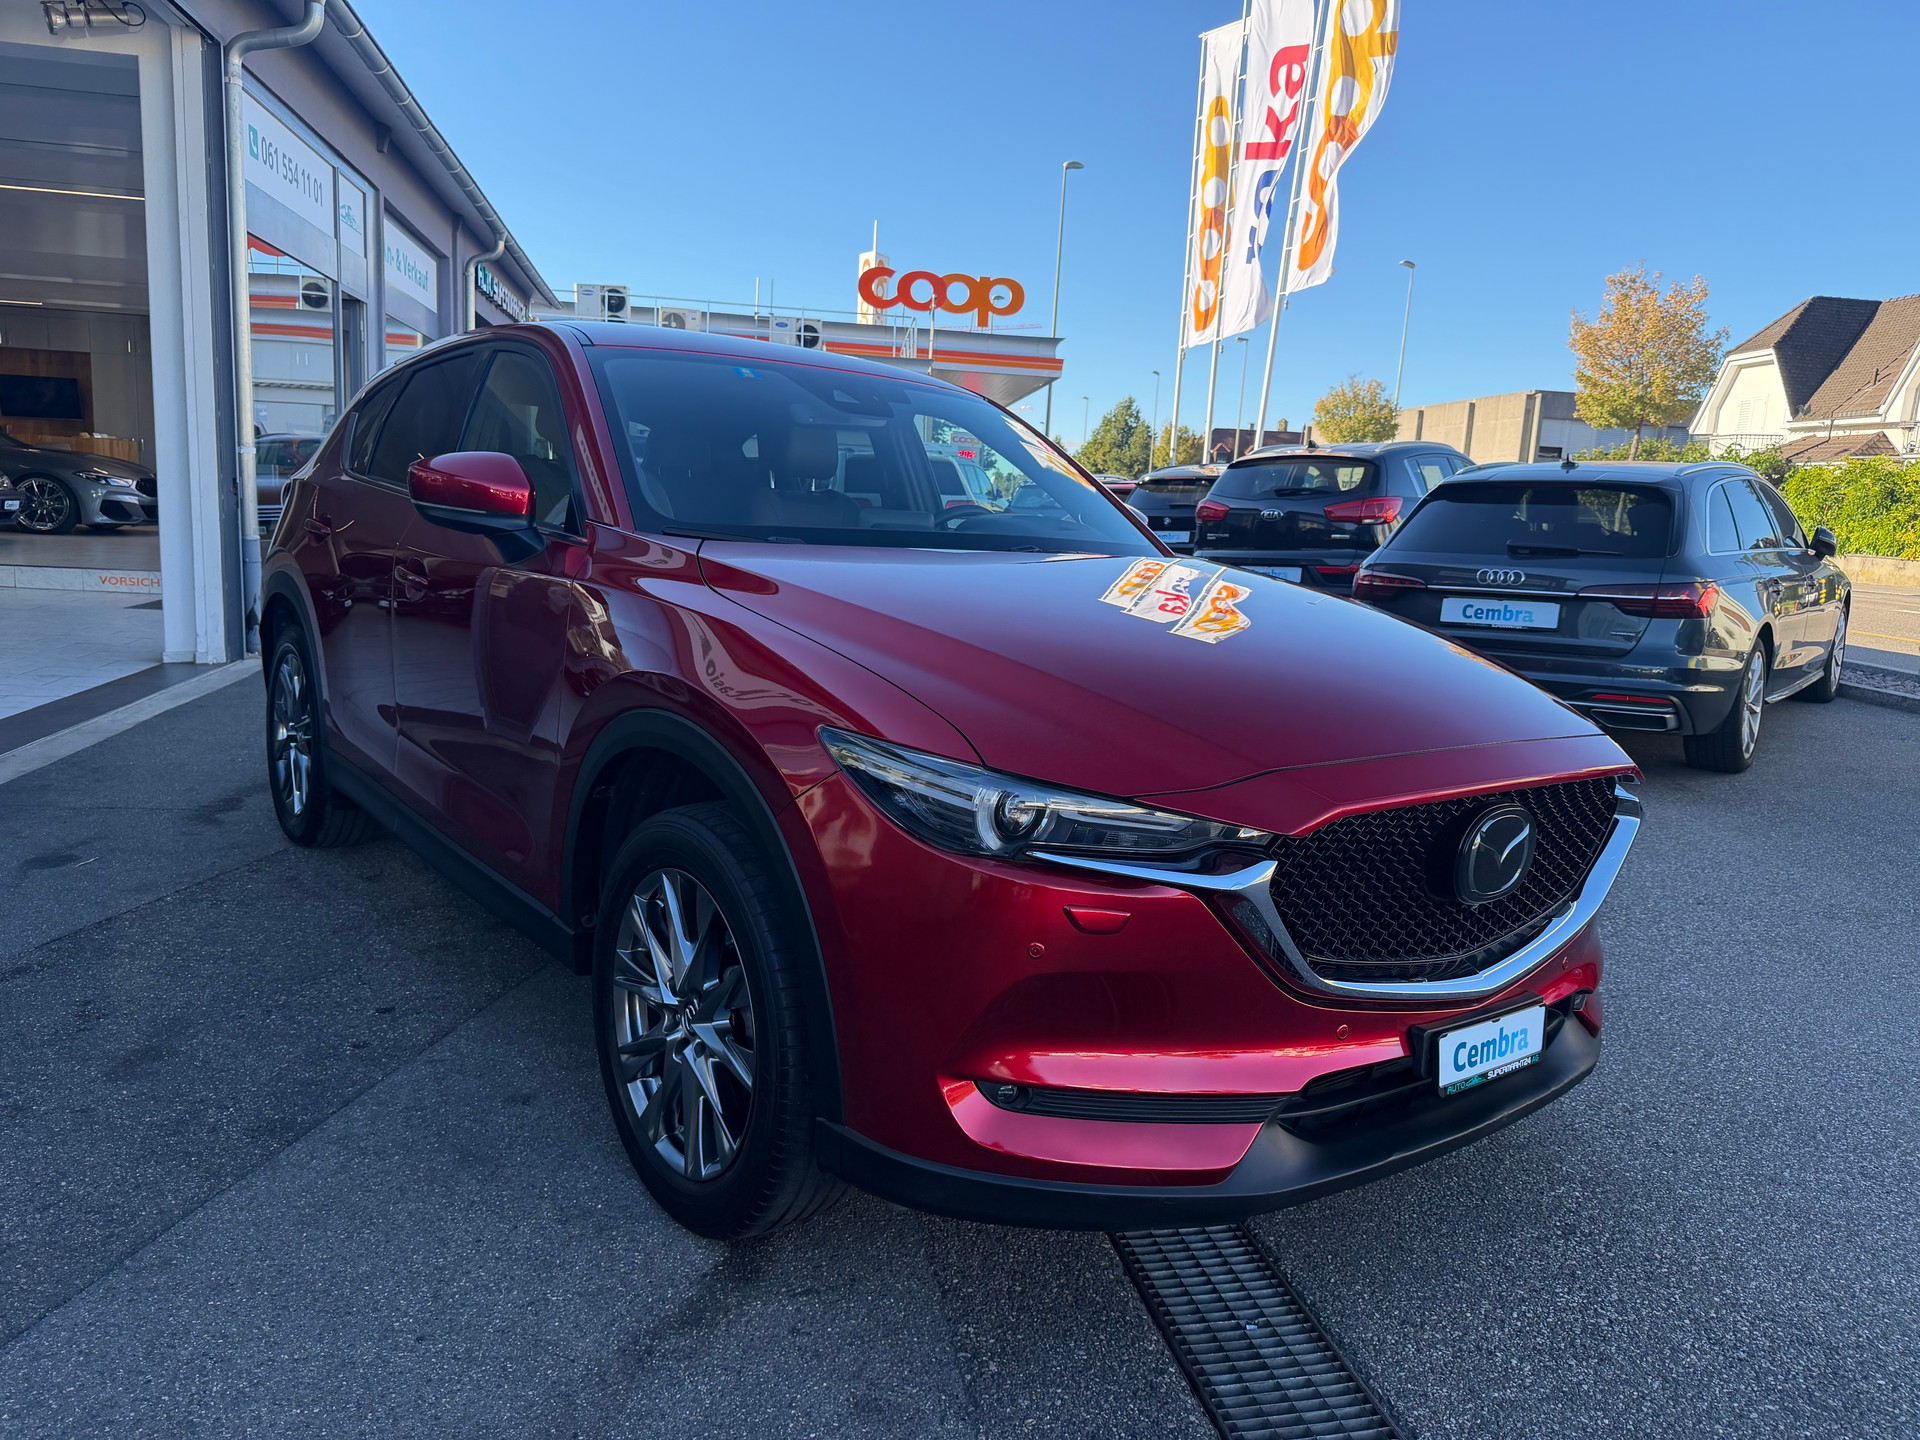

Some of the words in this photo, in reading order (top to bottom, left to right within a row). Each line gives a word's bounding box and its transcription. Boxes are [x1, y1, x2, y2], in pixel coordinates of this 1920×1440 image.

[261, 136, 279, 175] 061
[282, 152, 299, 189] 554
[301, 168, 311, 198] 11
[313, 177, 323, 208] 01
[396, 248, 401, 273] &
[402, 252, 429, 292] Verkauf
[858, 266, 1025, 328] coop
[1263, 511, 1280, 519] KIA
[1155, 532, 1180, 540] embra
[98, 576, 162, 588] VORSICH
[1462, 604, 1534, 623] Cembra
[1453, 1026, 1529, 1073] Cembra
[1446, 1081, 1466, 1095] AUTO
